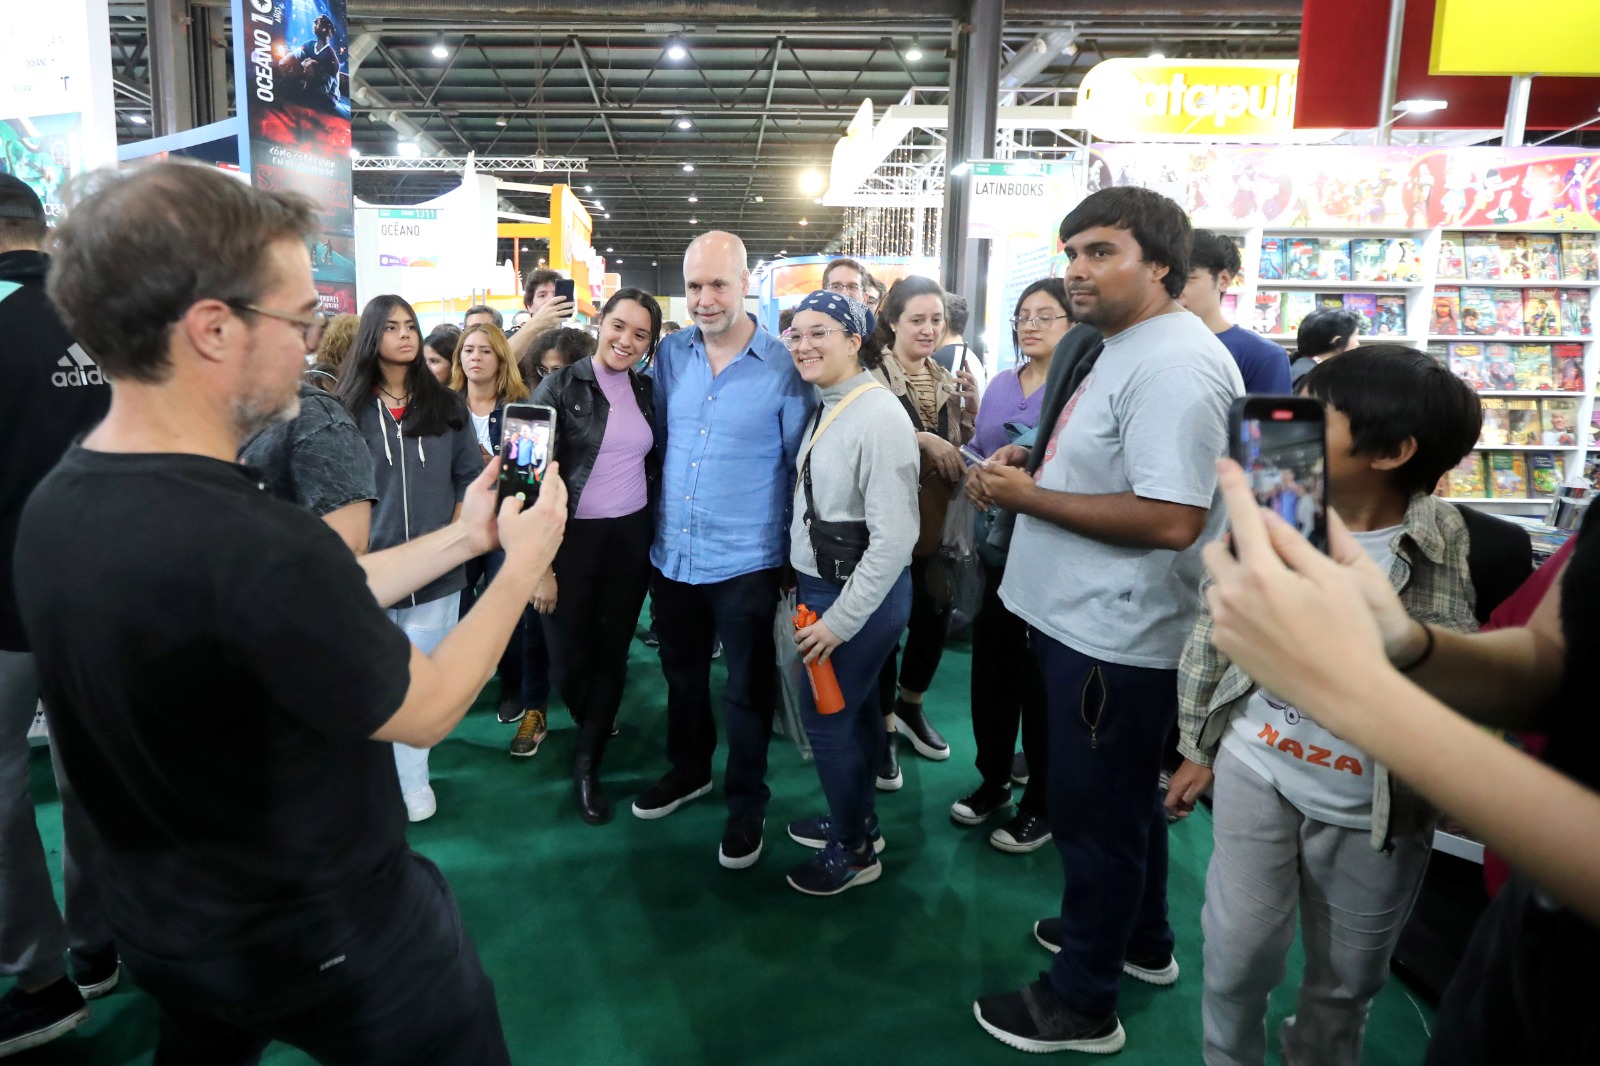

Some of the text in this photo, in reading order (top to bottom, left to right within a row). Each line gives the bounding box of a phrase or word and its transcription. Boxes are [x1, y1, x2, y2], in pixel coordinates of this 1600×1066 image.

[254, 29, 274, 102] OCEANO
[1100, 72, 1298, 127] atapul
[975, 182, 1044, 196] LATINBOOKS
[381, 221, 420, 236] OCÉANO
[415, 209, 435, 218] 1311
[1257, 722, 1363, 776] NAZA
